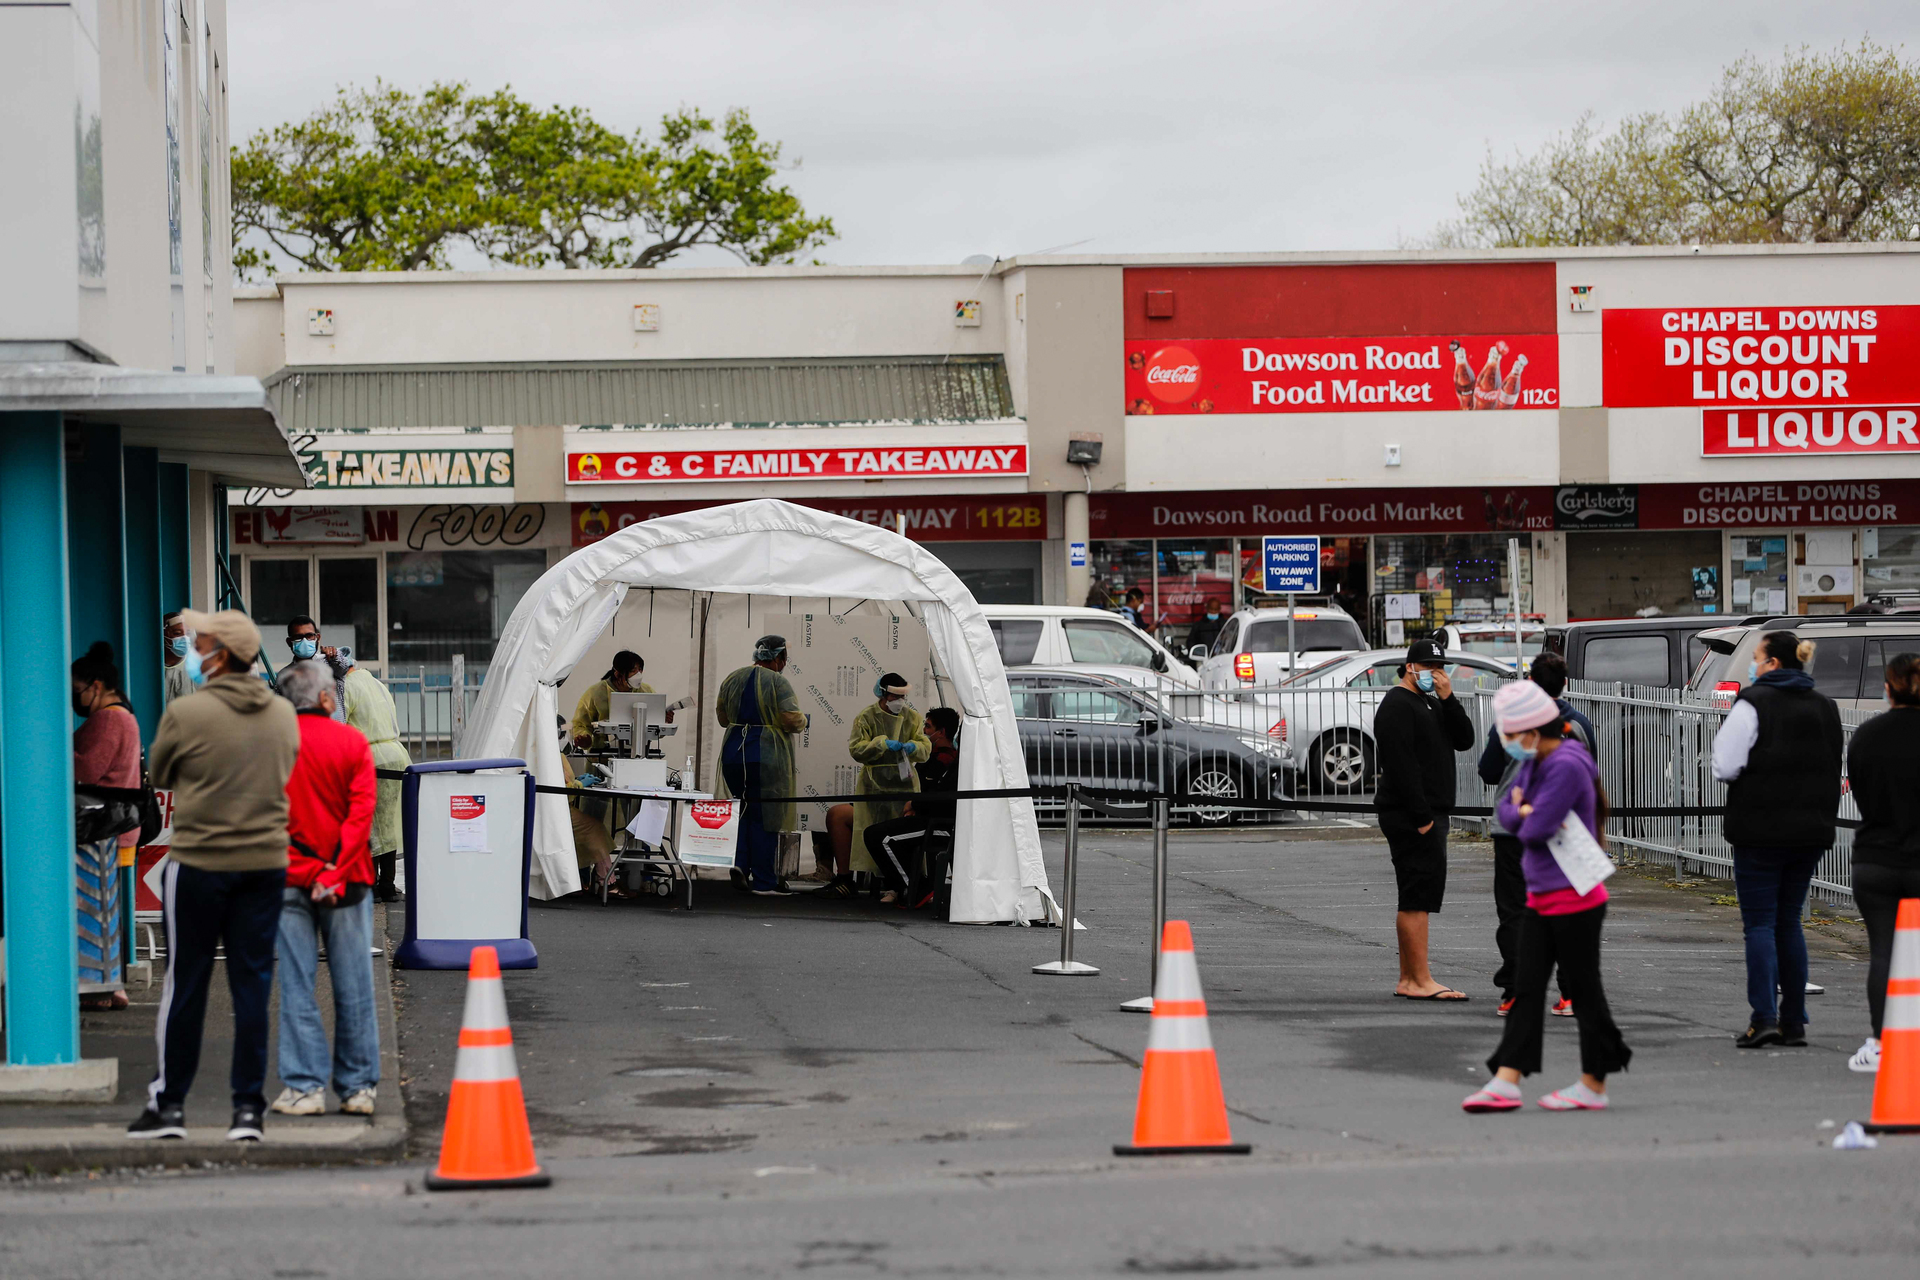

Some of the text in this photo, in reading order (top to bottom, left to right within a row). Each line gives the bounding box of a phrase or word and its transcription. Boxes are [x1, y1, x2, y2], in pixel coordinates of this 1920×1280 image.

[1662, 310, 1877, 332] CHAPEL DOWNS
[1242, 346, 1441, 371] Dawson Road
[1665, 335, 1876, 366] DISCOUNT
[1147, 365, 1199, 384] Coca-Cola
[1693, 369, 1849, 401] LIQUOR
[1251, 379, 1434, 405] Food Market
[1522, 388, 1557, 405] 112C
[1727, 411, 1920, 450] LIQUOR
[322, 451, 510, 485] TAKEAWAYS
[615, 449, 1018, 477] C & C FAMILY TAKEAWAY
[1556, 487, 1635, 514] Carlsberg
[1698, 484, 1881, 503] CHAPEL DOWNS
[976, 508, 1042, 527] 112B
[1153, 502, 1465, 526] Dawson Road Food Market
[1526, 516, 1553, 528] 112C
[1683, 504, 1898, 524] DISCOUNT LIQUOR
[407, 503, 545, 550] FOOD
[1272, 553, 1310, 561] PARKING
[1269, 567, 1289, 575] TOW
[1289, 567, 1314, 575] AWAY
[1280, 577, 1303, 586] ZONE
[1431, 643, 1442, 656] LA
[694, 801, 729, 817] Stop!
